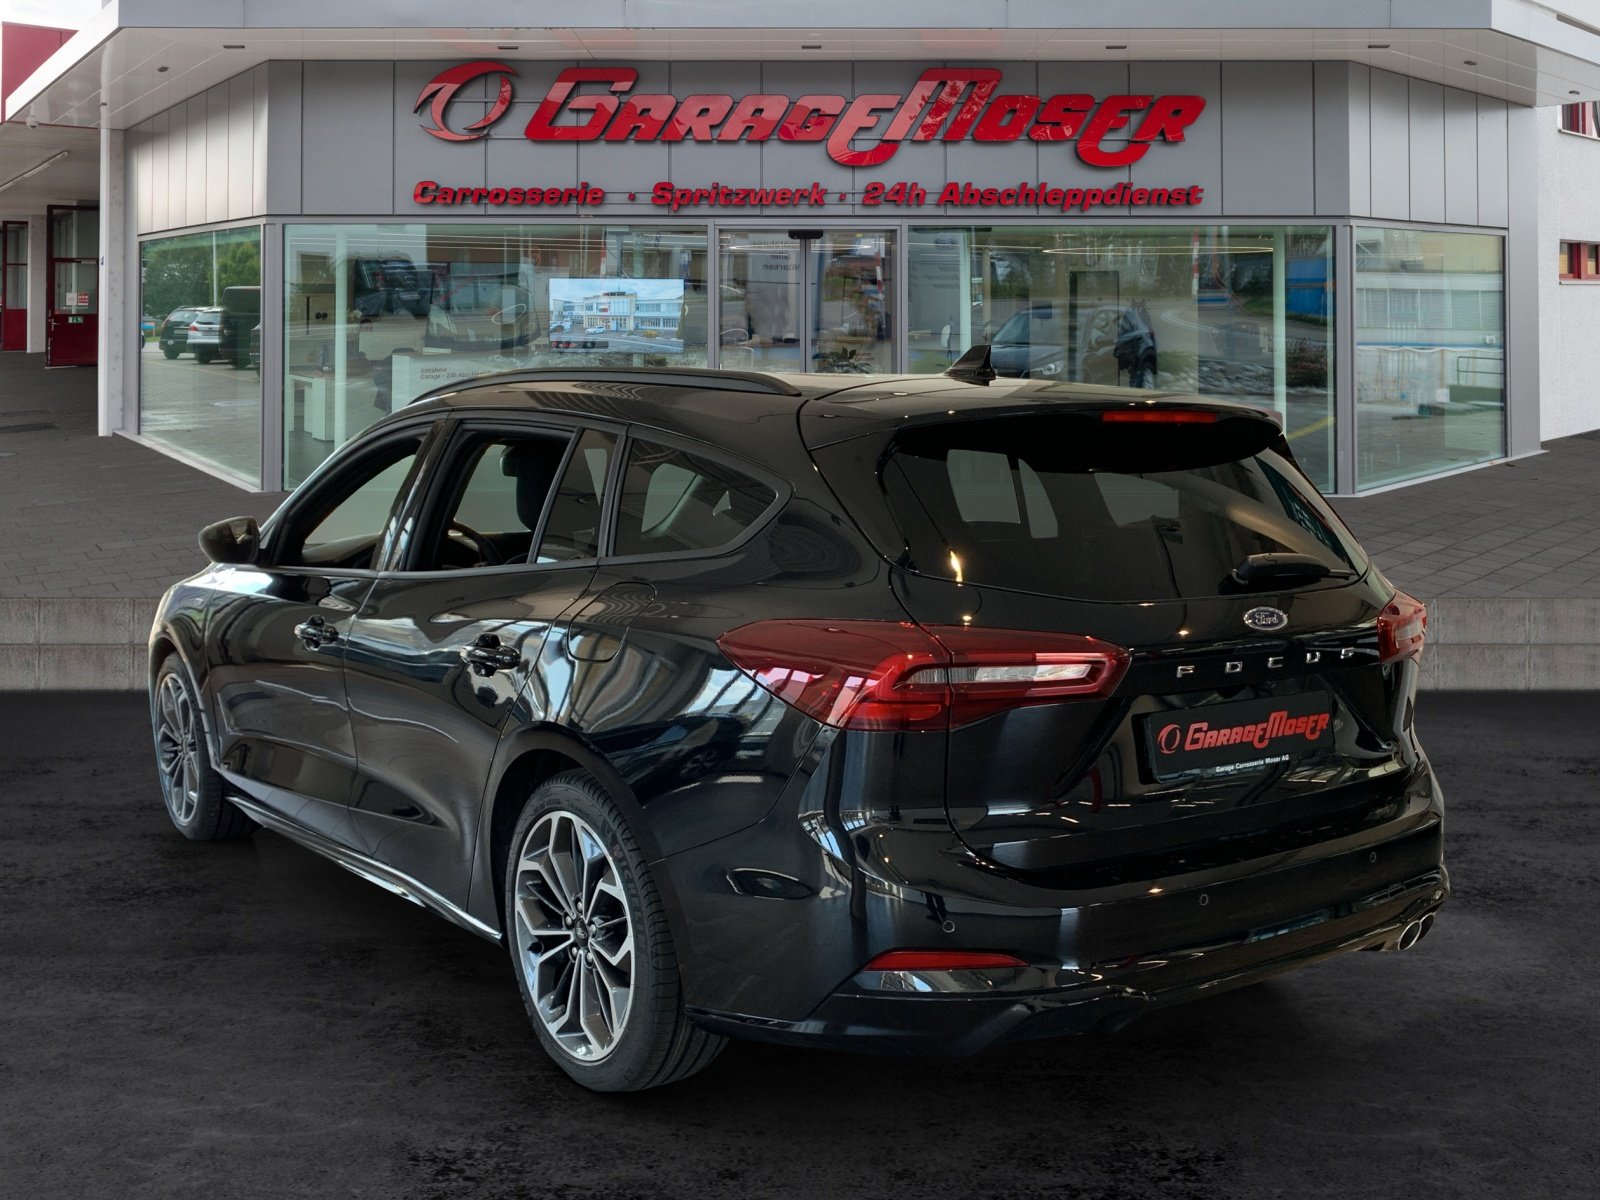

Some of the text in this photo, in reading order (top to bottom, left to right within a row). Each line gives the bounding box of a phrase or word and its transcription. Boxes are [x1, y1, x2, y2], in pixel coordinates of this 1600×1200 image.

[413, 181, 1204, 212] Carrosserie Spritzwerk 24h Abschleppdienst
[1255, 611, 1279, 625] Ford
[1215, 764, 1235, 773] Garage
[1265, 756, 1281, 764] Moser
